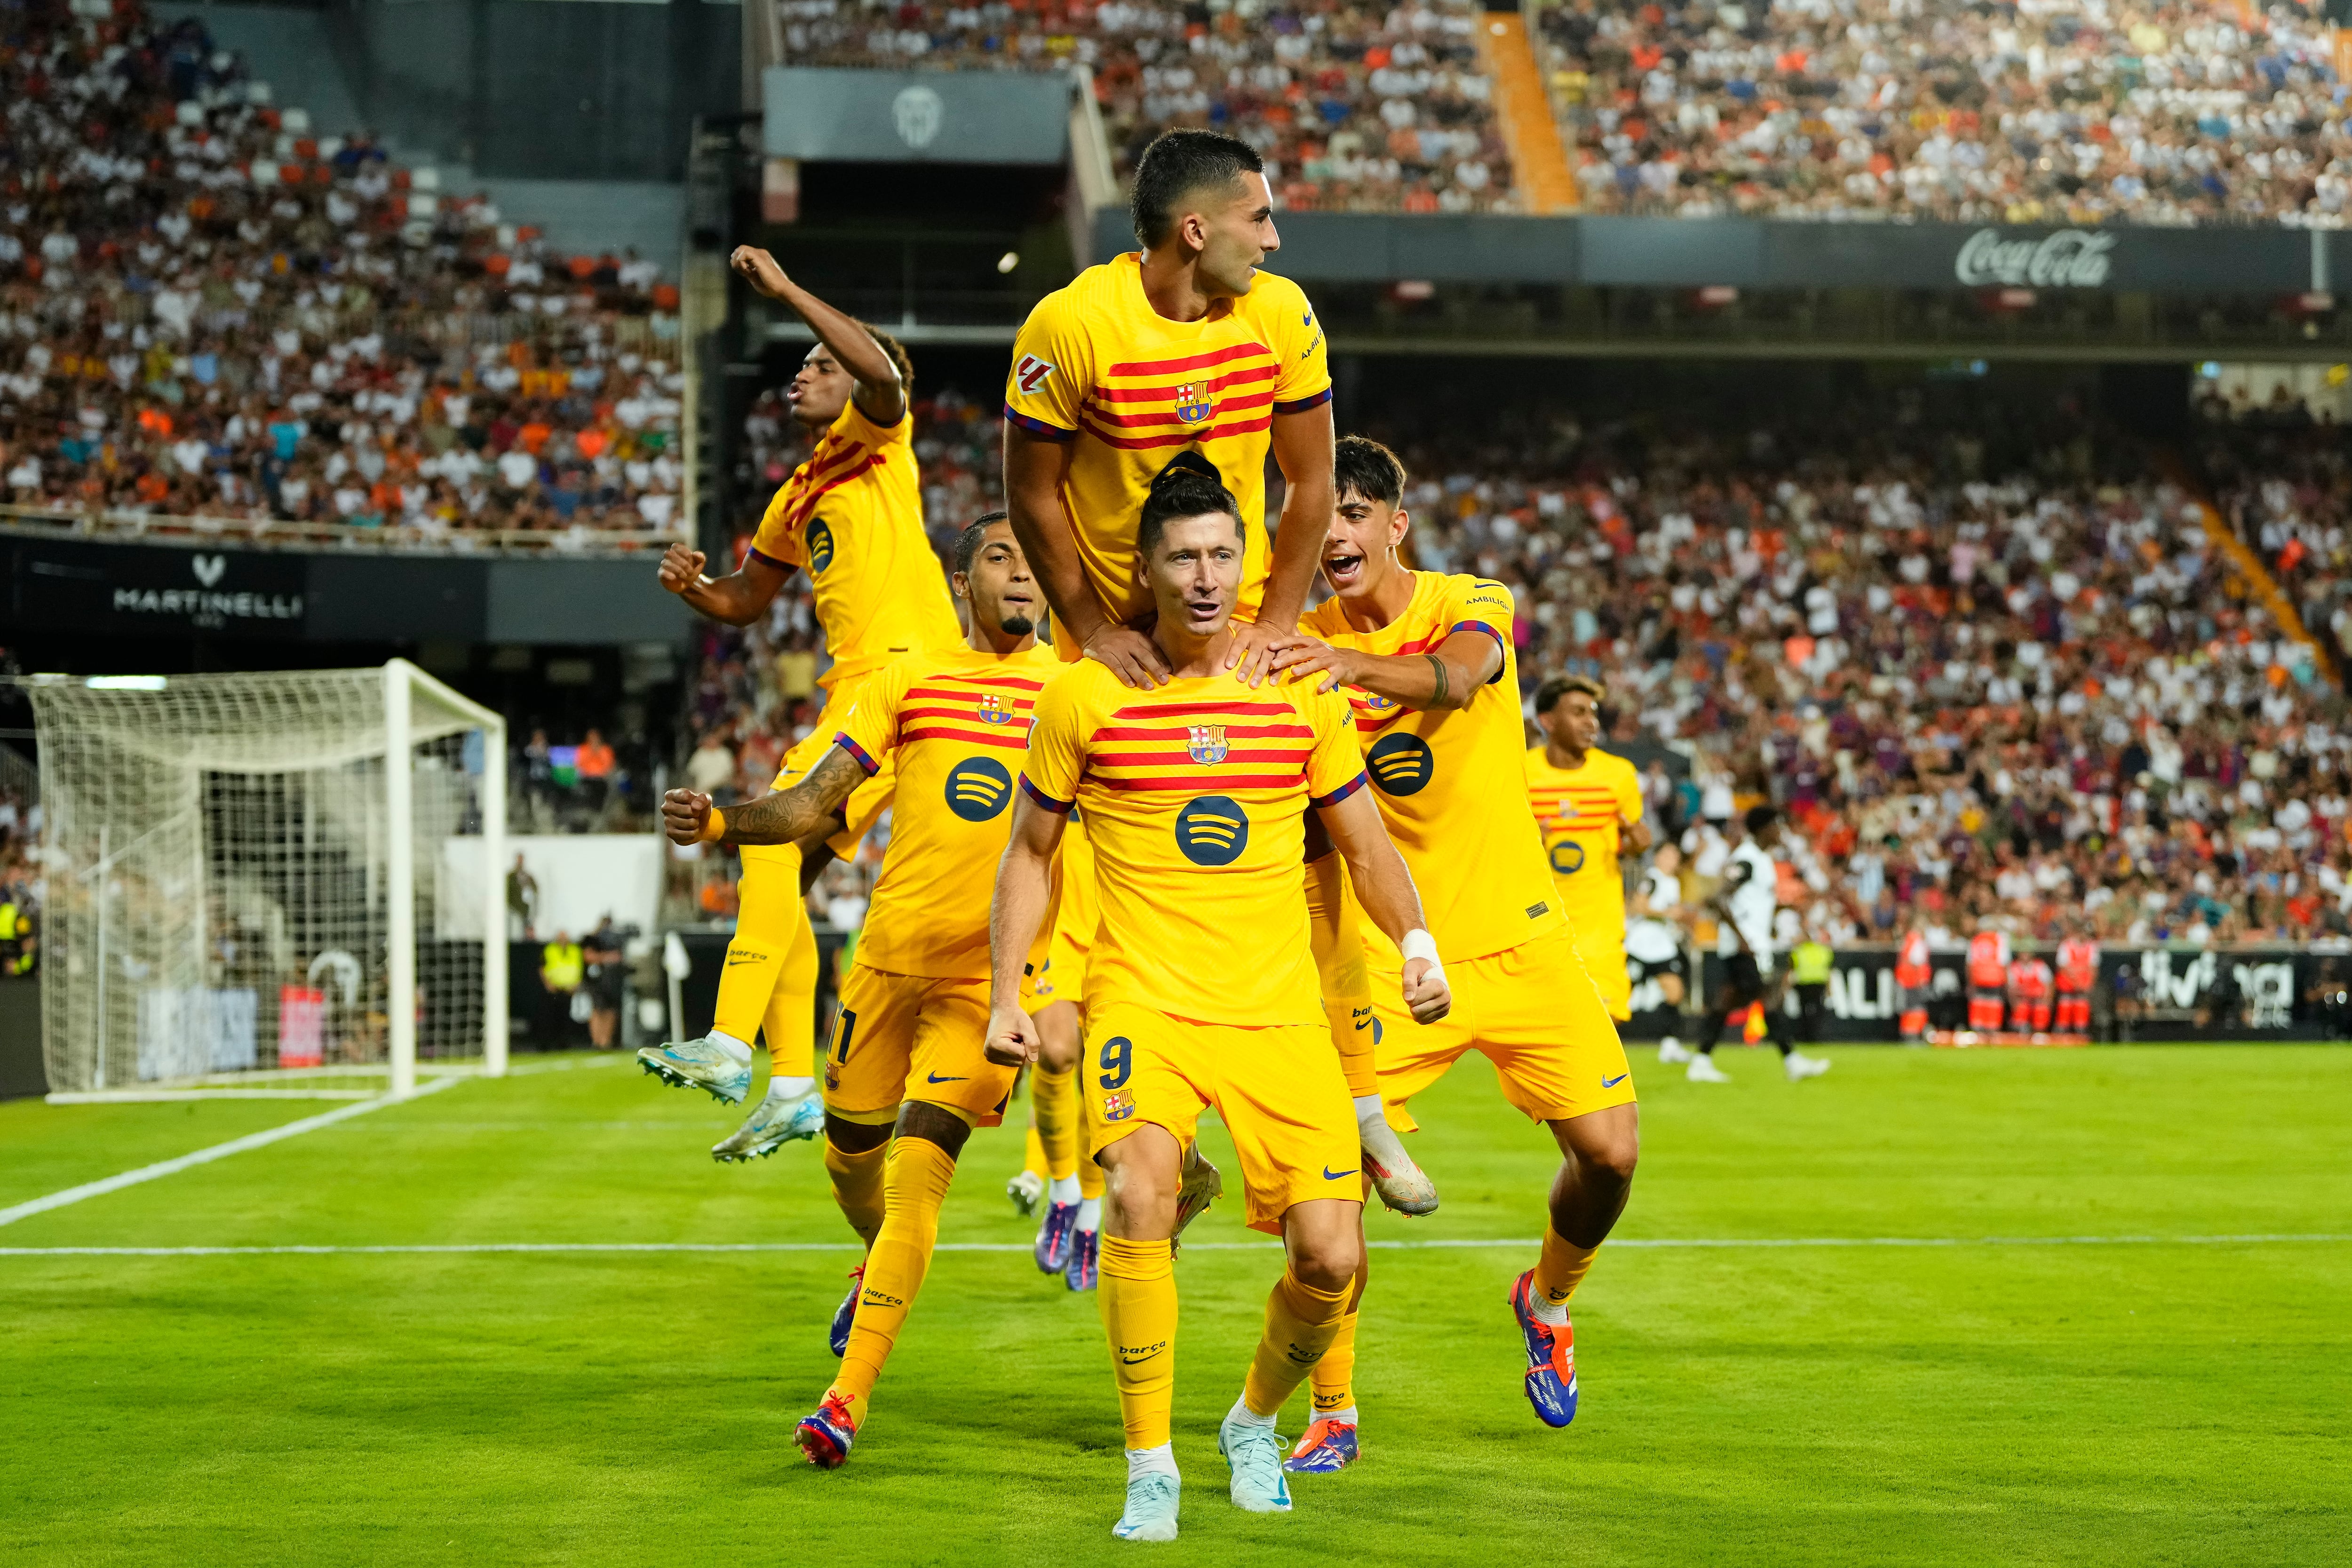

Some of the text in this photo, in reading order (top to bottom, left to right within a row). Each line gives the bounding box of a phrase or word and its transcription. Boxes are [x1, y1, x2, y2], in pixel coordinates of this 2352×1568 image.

[113, 587, 304, 619] MARTINELLI
[827, 1000, 857, 1065] 11
[1099, 1036, 1132, 1090] 9
[865, 1287, 903, 1305] barça
[1119, 1340, 1166, 1354] barça
[1312, 1390, 1345, 1402] barça
